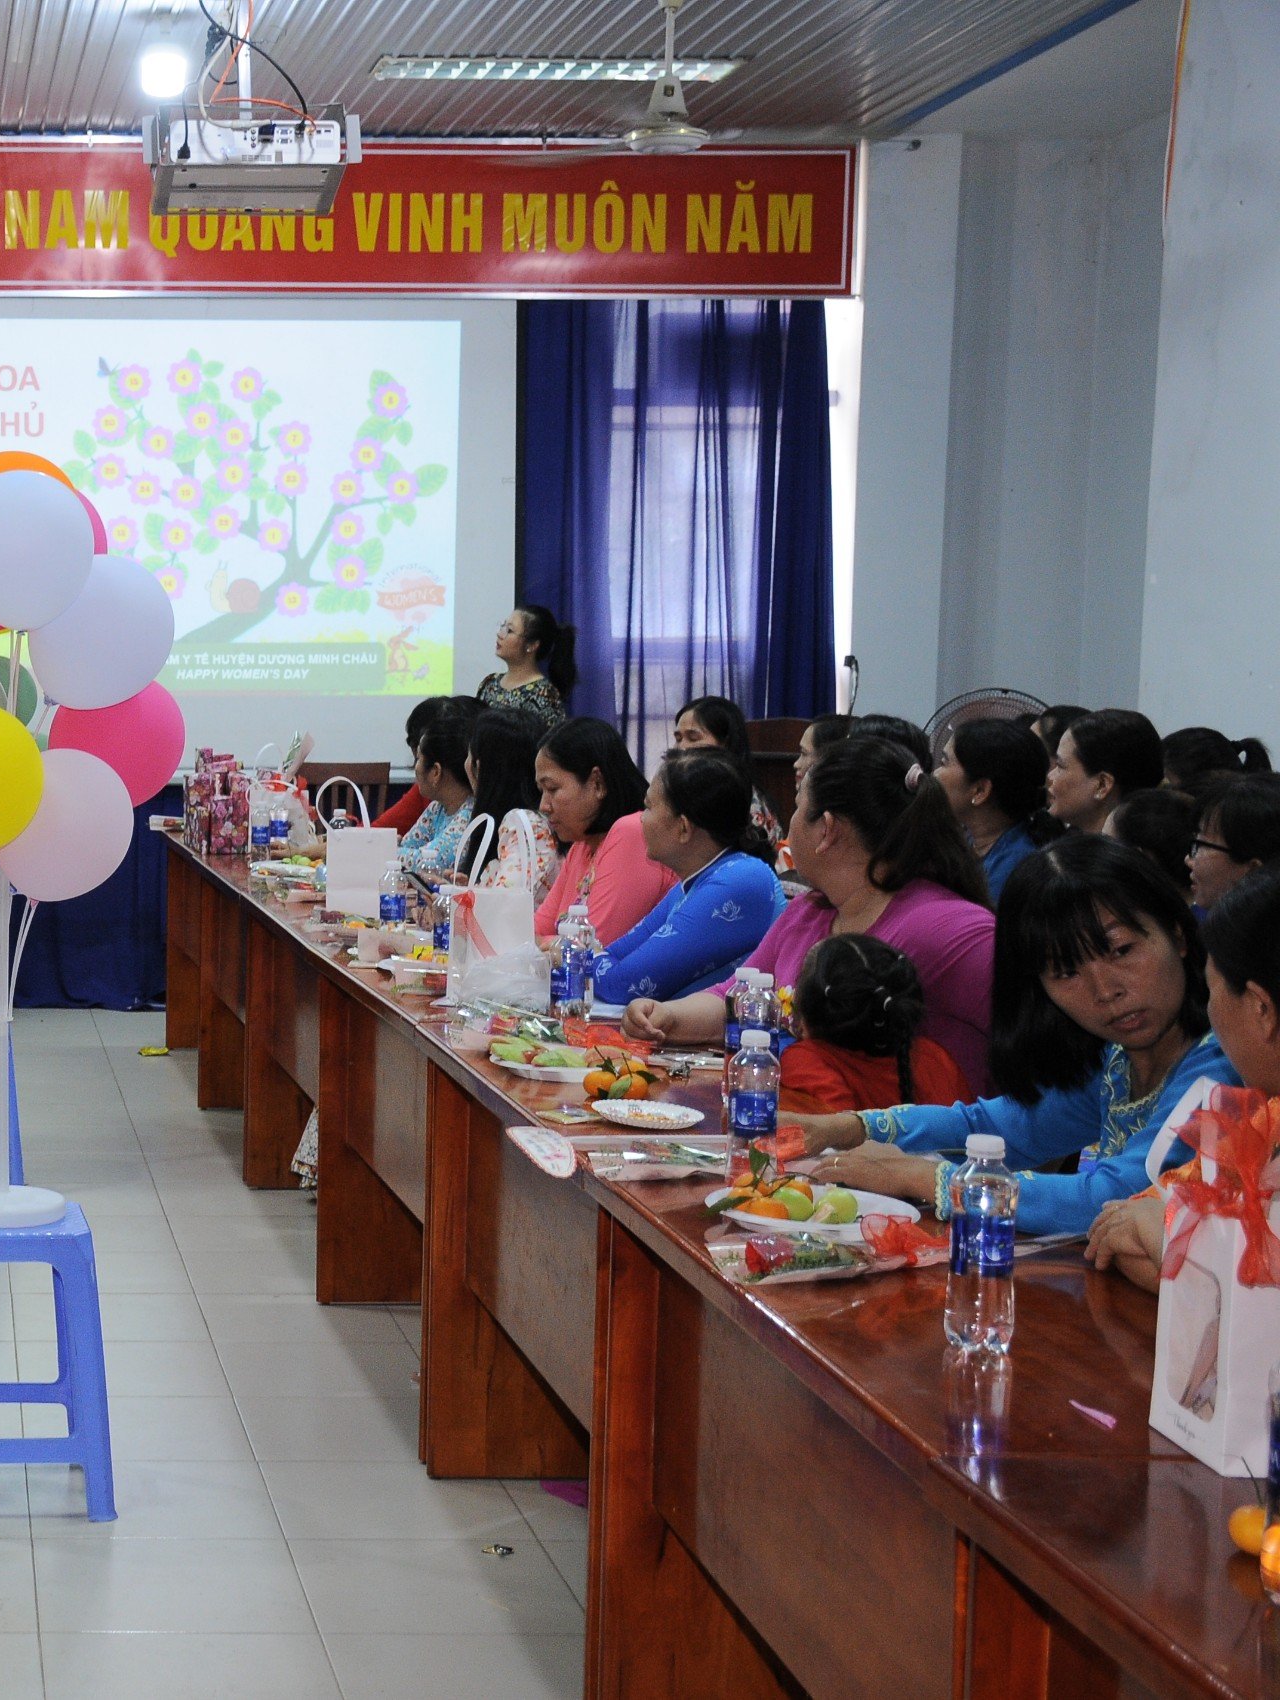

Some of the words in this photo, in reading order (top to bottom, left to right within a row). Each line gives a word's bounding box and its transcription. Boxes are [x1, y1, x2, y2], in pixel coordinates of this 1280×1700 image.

[4, 188, 130, 250] NAM
[353, 193, 483, 253] VINH
[502, 181, 668, 253] MUÔN
[686, 179, 814, 253] NĂM
[182, 654, 191, 664] Y
[212, 653, 255, 667] HUYỆN
[308, 653, 339, 665] MINH
[342, 651, 379, 665] CHÂU
[176, 668, 218, 680] HAPPY
[220, 668, 281, 680] WOMEN'S
[283, 668, 310, 680] DAY
